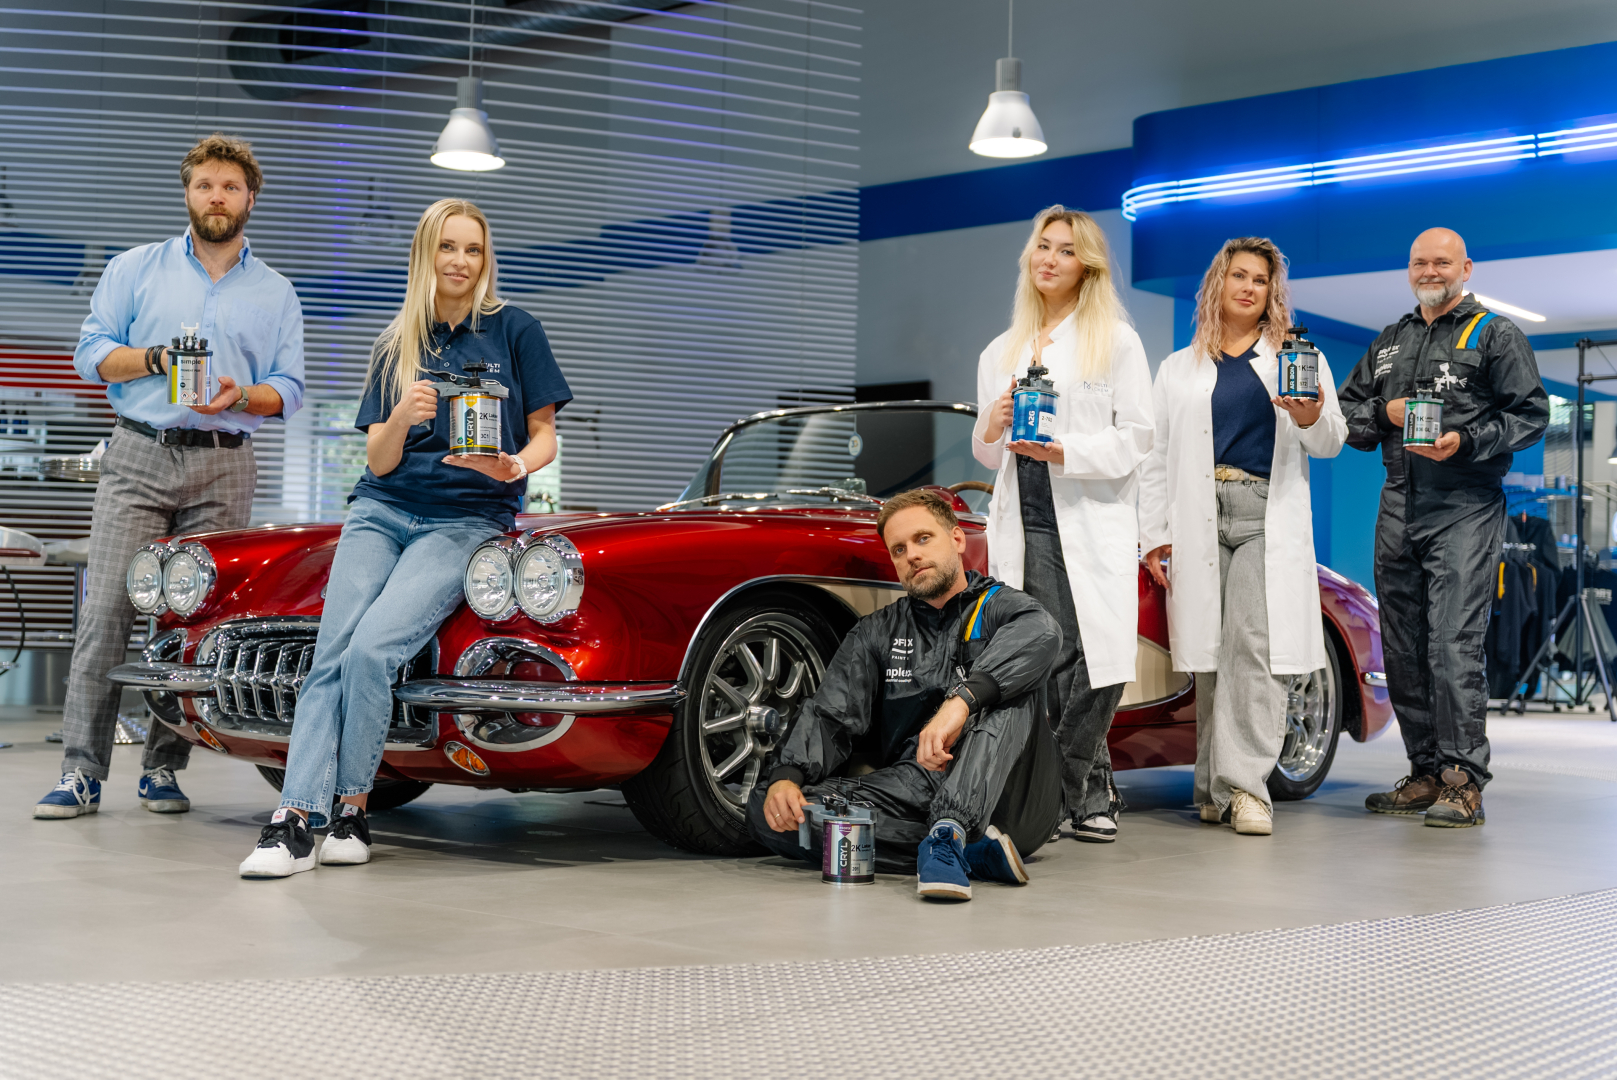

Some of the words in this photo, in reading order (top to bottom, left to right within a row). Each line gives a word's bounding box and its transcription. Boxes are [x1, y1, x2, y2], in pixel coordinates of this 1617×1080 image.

[1028, 410, 1036, 426] A2G
[851, 844, 861, 852] 2K
[840, 842, 848, 874] ACRYL
